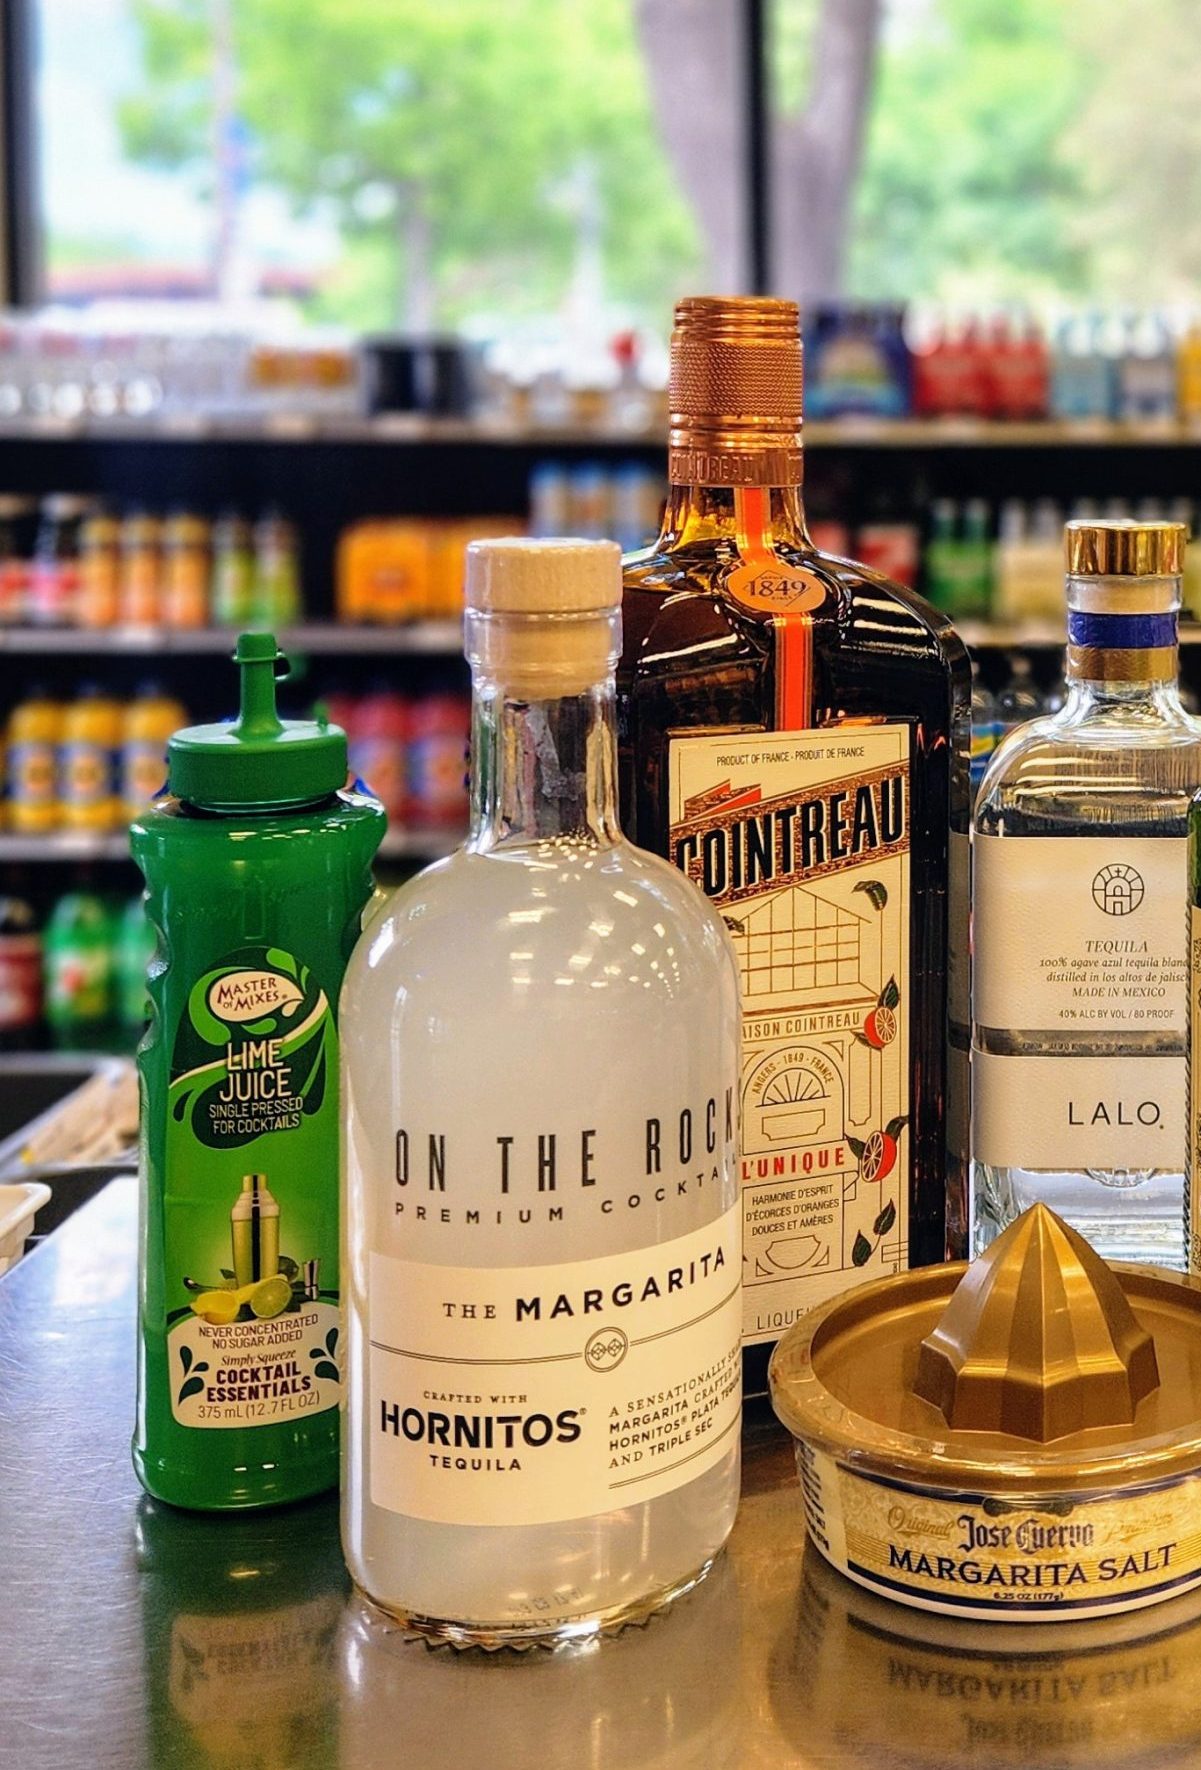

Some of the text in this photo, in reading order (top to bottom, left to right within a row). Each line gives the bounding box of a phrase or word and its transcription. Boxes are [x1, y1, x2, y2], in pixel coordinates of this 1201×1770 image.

[750, 580, 806, 596] 1849
[717, 747, 864, 766] PRODUCT OF FRANCE PRODUIT DE FRANCE
[676, 775, 904, 898] COINTREAU
[1086, 940, 1148, 955] TEQUILA
[1040, 957, 1159, 970] 100% agave azul tequila
[1046, 972, 1156, 982] distilled in los altos de
[217, 977, 276, 1003] MASTER
[234, 990, 279, 1011] MIXES
[1072, 987, 1165, 997] MADE IN MEXICO
[786, 1011, 860, 1034] COINTREAU
[1059, 1009, 1077, 1018] 40%
[1079, 1009, 1096, 1018] ALC
[1098, 1009, 1108, 1018] BY
[1111, 1009, 1126, 1019] VOL
[1134, 1009, 1144, 1019] 80
[1147, 1009, 1175, 1019] PROOF
[227, 1038, 284, 1070] LIME
[810, 1056, 834, 1083] FRANCE
[219, 1068, 292, 1102] JUICE
[209, 1096, 303, 1118] SINGLE PRESSED
[213, 1113, 300, 1134] FOR COCKTAILS
[396, 1129, 446, 1192] ON
[497, 1129, 597, 1193] THE
[742, 1147, 844, 1180] L'UNIQUE
[752, 1184, 833, 1206] HARMONIE D'ESPRIT
[395, 1202, 564, 1224] PREMIUM
[793, 1199, 839, 1214] D'ORANGES
[752, 1214, 834, 1236] DOUCES ET AMÈRES
[443, 1246, 725, 1322] THE MARGARITA
[199, 1313, 318, 1337] NEVER CONCENTRATED
[212, 1330, 303, 1349] NO SUGAR ADDED
[221, 1349, 296, 1367] Simply Squeeze
[216, 1361, 301, 1384] COCKTAIL
[207, 1376, 311, 1402] ESSENTIALS
[423, 1390, 527, 1404] CRAFTED WITH
[609, 1356, 726, 1417] A SENSATIONALLY
[198, 1405, 221, 1418] 375
[224, 1405, 244, 1418] mL
[281, 1398, 296, 1412] FL
[299, 1390, 320, 1408] OZ)
[609, 1368, 732, 1434] MARGARITA CRAFTED
[691, 1396, 719, 1422] PLATA
[609, 1417, 713, 1469] AND TRIPLE SEC
[430, 1454, 521, 1471] TEQUILA
[958, 1514, 1010, 1552] Jose
[1016, 1518, 1094, 1555] Cuervo
[889, 1543, 1176, 1586] MARGARITA SALT
[1017, 1592, 1032, 1600] OZ
